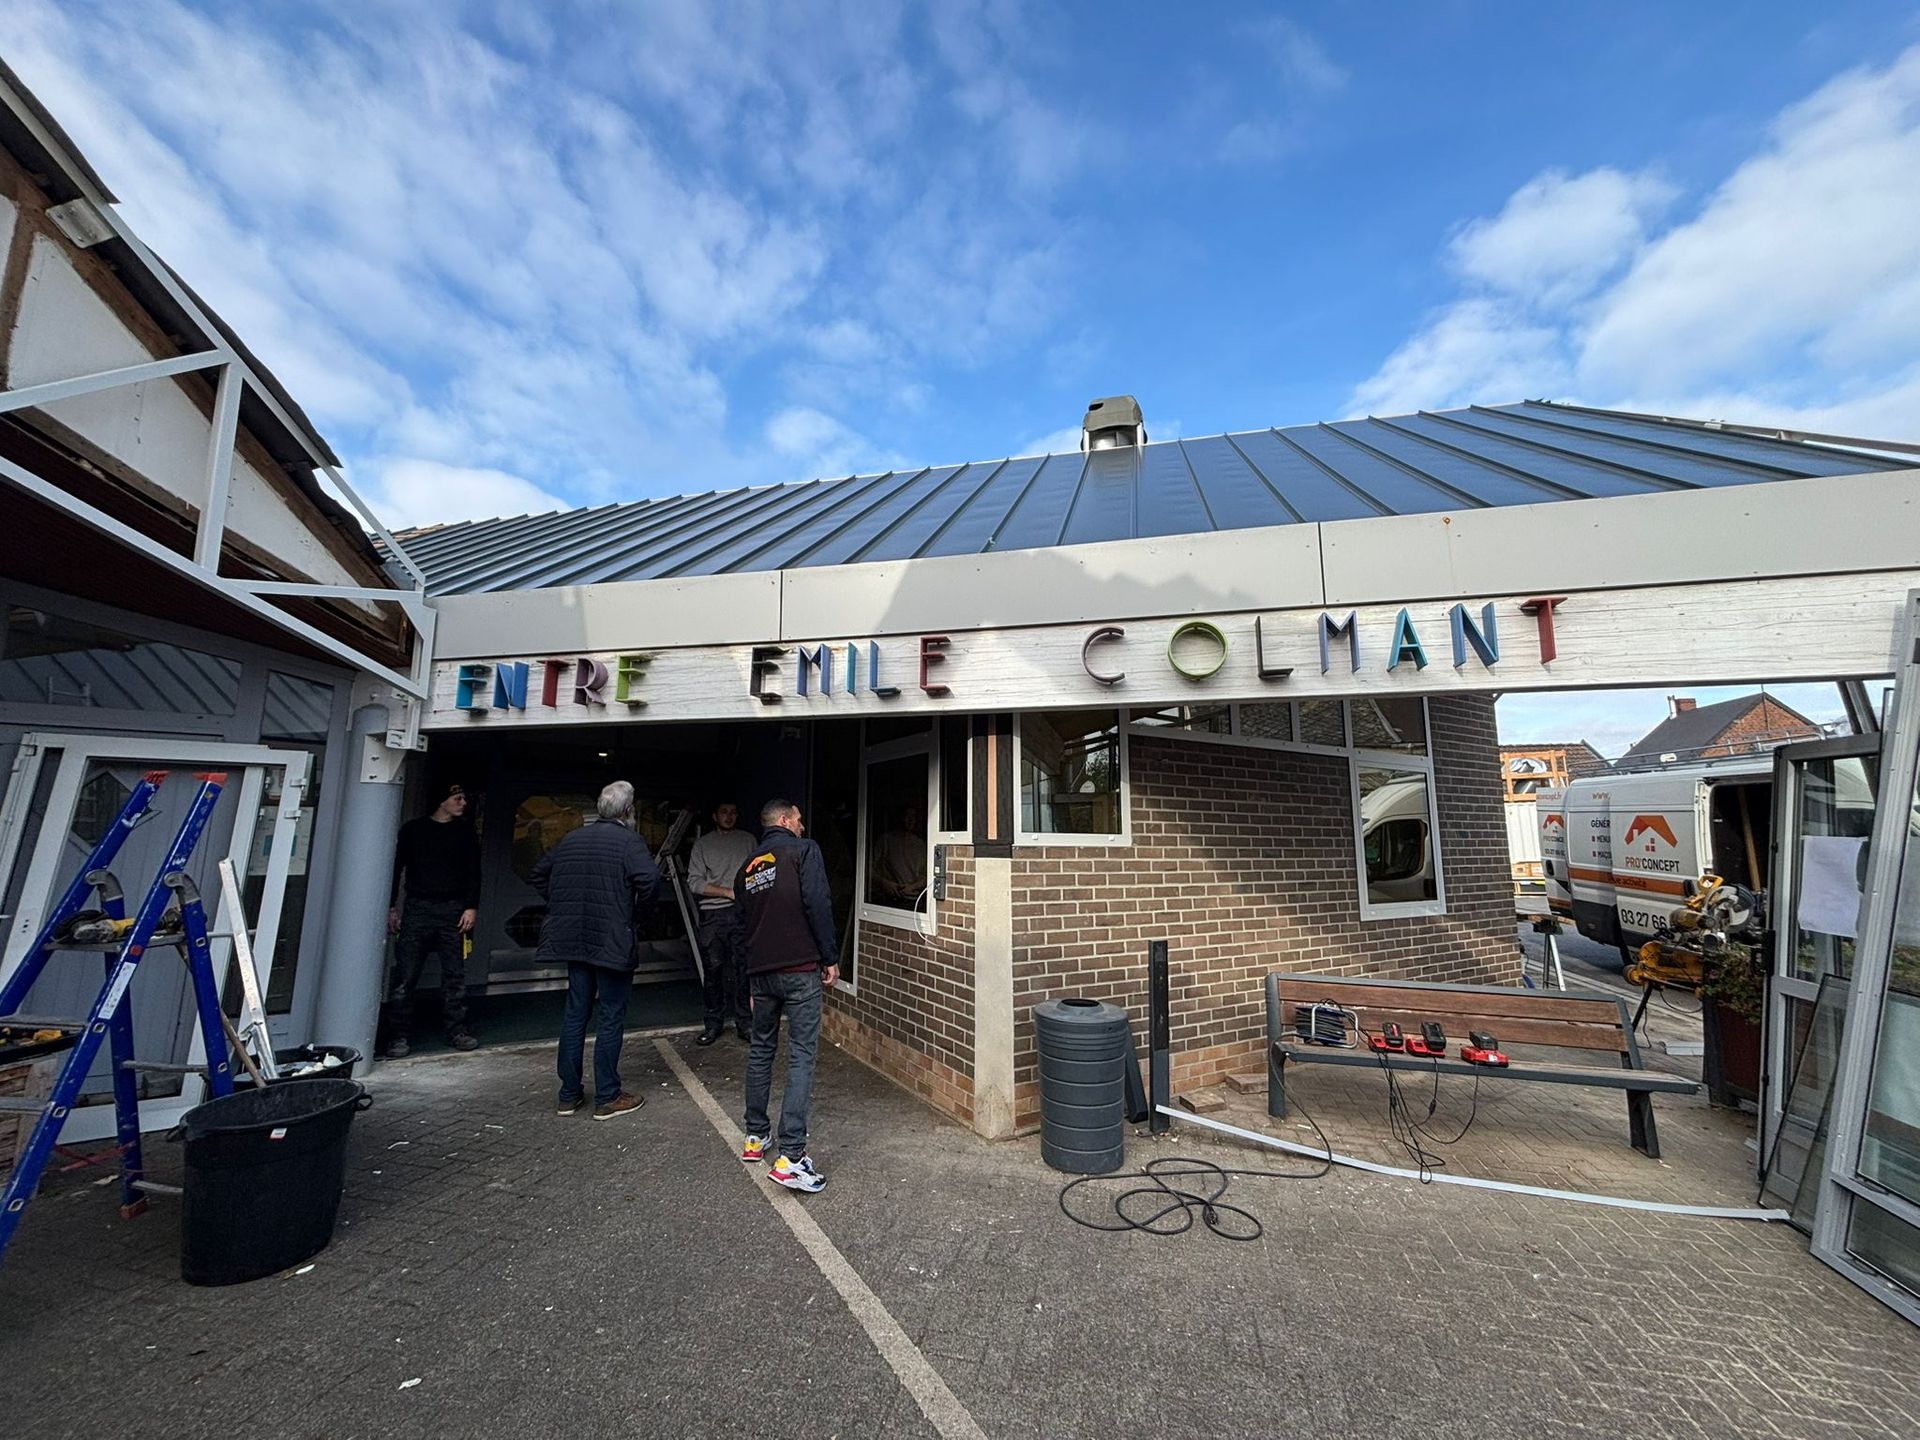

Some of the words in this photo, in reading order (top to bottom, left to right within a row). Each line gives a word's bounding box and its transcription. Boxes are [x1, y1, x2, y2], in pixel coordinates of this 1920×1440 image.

[455, 654, 653, 713] ENTRE
[749, 635, 951, 705] EMILE
[1080, 596, 1569, 685] COLMANT
[1621, 909, 1635, 925] 03
[1636, 911, 1649, 928] 27
[1651, 914, 1668, 930] 66
